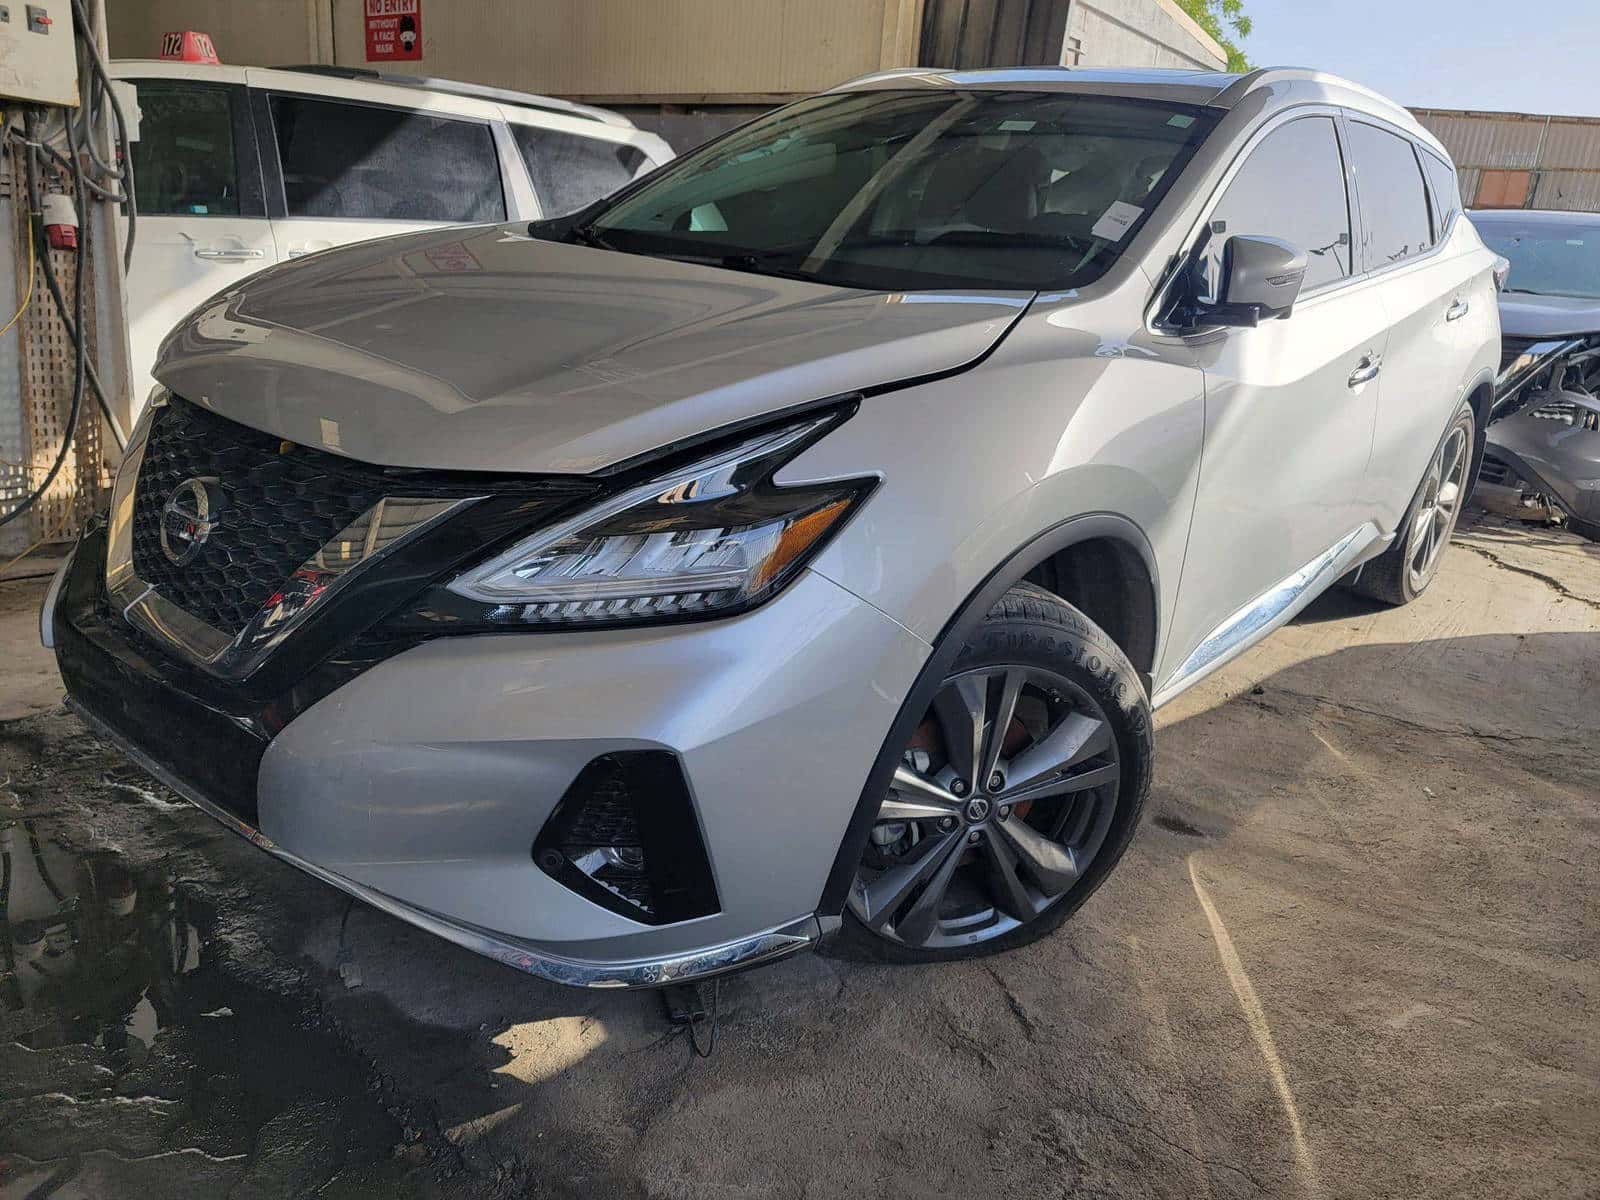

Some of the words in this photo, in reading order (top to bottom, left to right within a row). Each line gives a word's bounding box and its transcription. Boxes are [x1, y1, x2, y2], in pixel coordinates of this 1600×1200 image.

[368, 0, 382, 13] NO
[385, 0, 415, 12] ENTRY
[162, 33, 182, 56] 172
[375, 44, 394, 53] MASK
